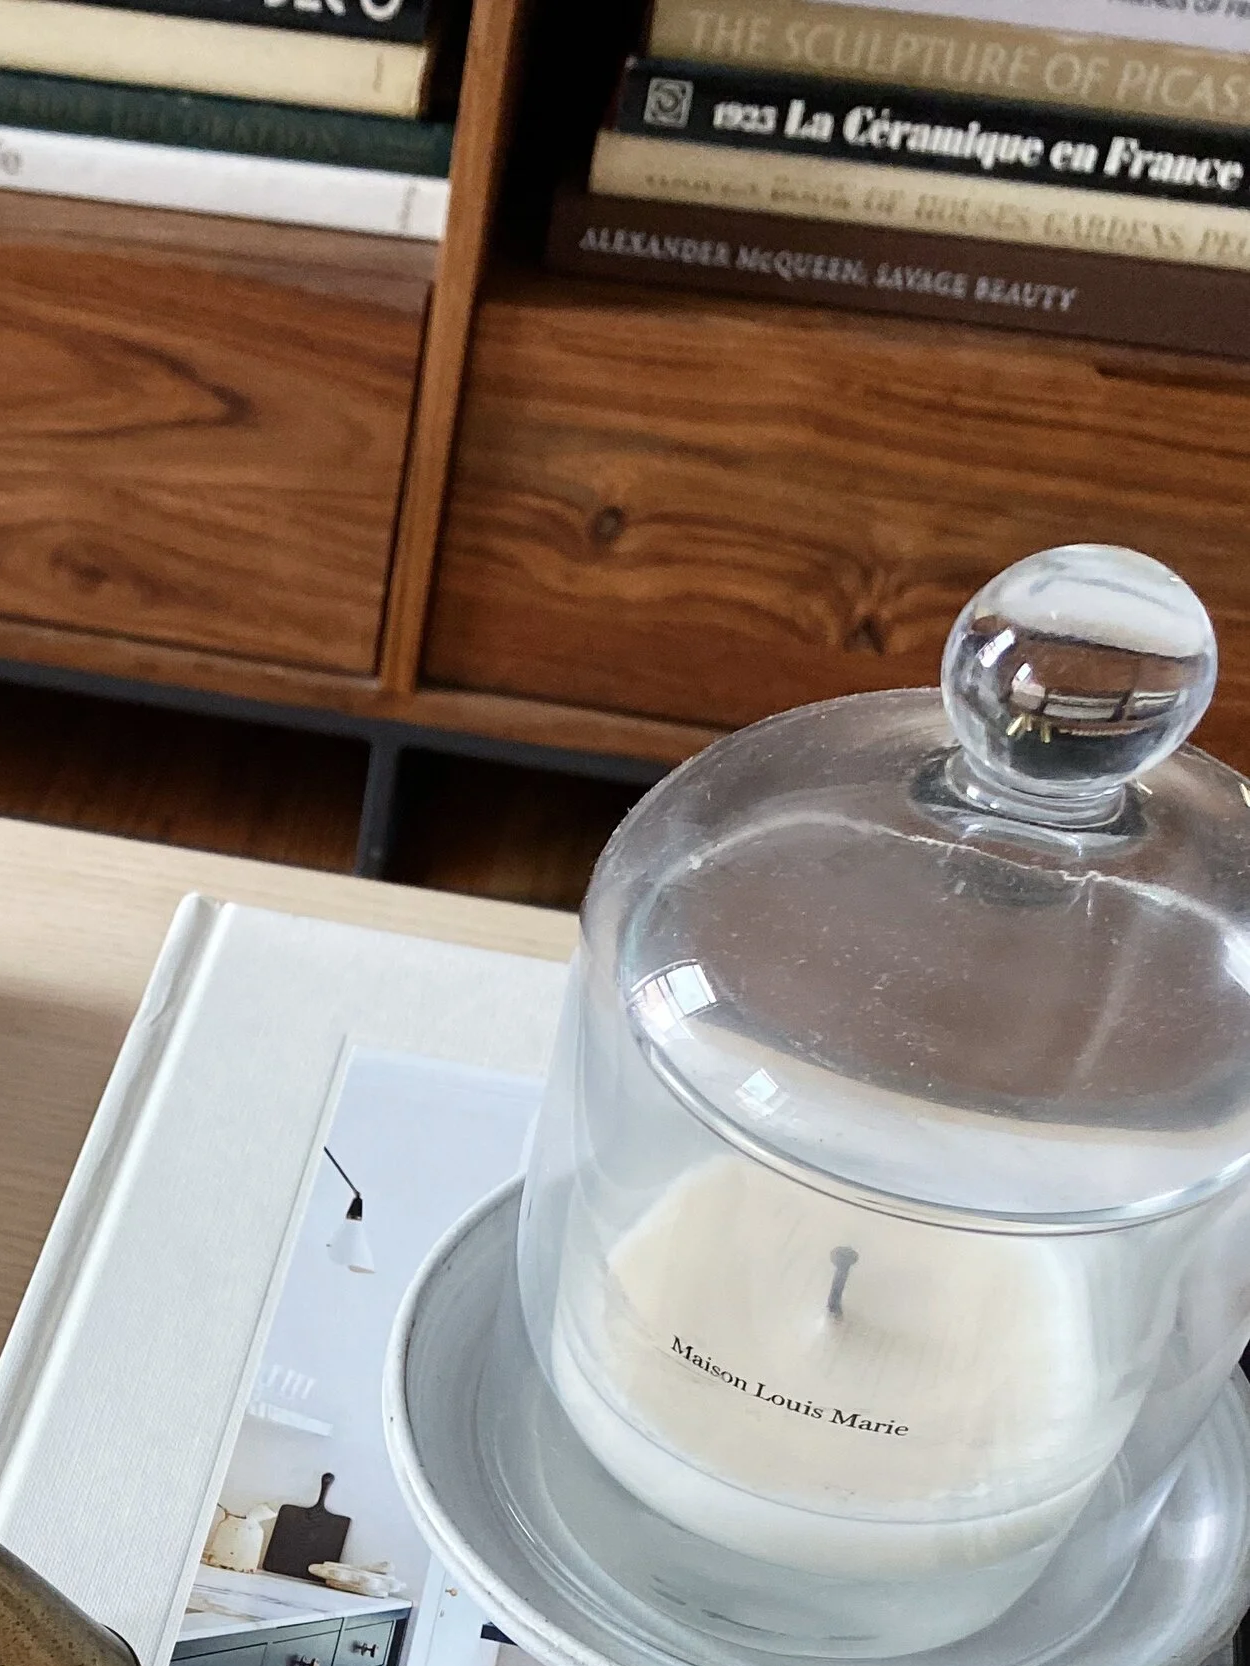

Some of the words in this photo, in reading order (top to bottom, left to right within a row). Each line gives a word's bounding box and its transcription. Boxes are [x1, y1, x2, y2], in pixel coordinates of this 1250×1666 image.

[689, 9, 772, 57] THE
[785, 20, 1039, 89] SCULPTURE
[1044, 52, 1110, 99] OF
[1115, 60, 1250, 112] PICAS
[784, 99, 835, 143] La
[842, 105, 1045, 170] Céramique
[1049, 140, 1099, 173] en
[1103, 135, 1245, 191] France
[578, 226, 733, 269] ALEXANDER
[874, 261, 969, 300] SAVAGE
[974, 275, 1079, 312] BEAUTY
[670, 1334, 747, 1392] Maison
[753, 1382, 825, 1419] Louis
[828, 1407, 910, 1437] Marie
